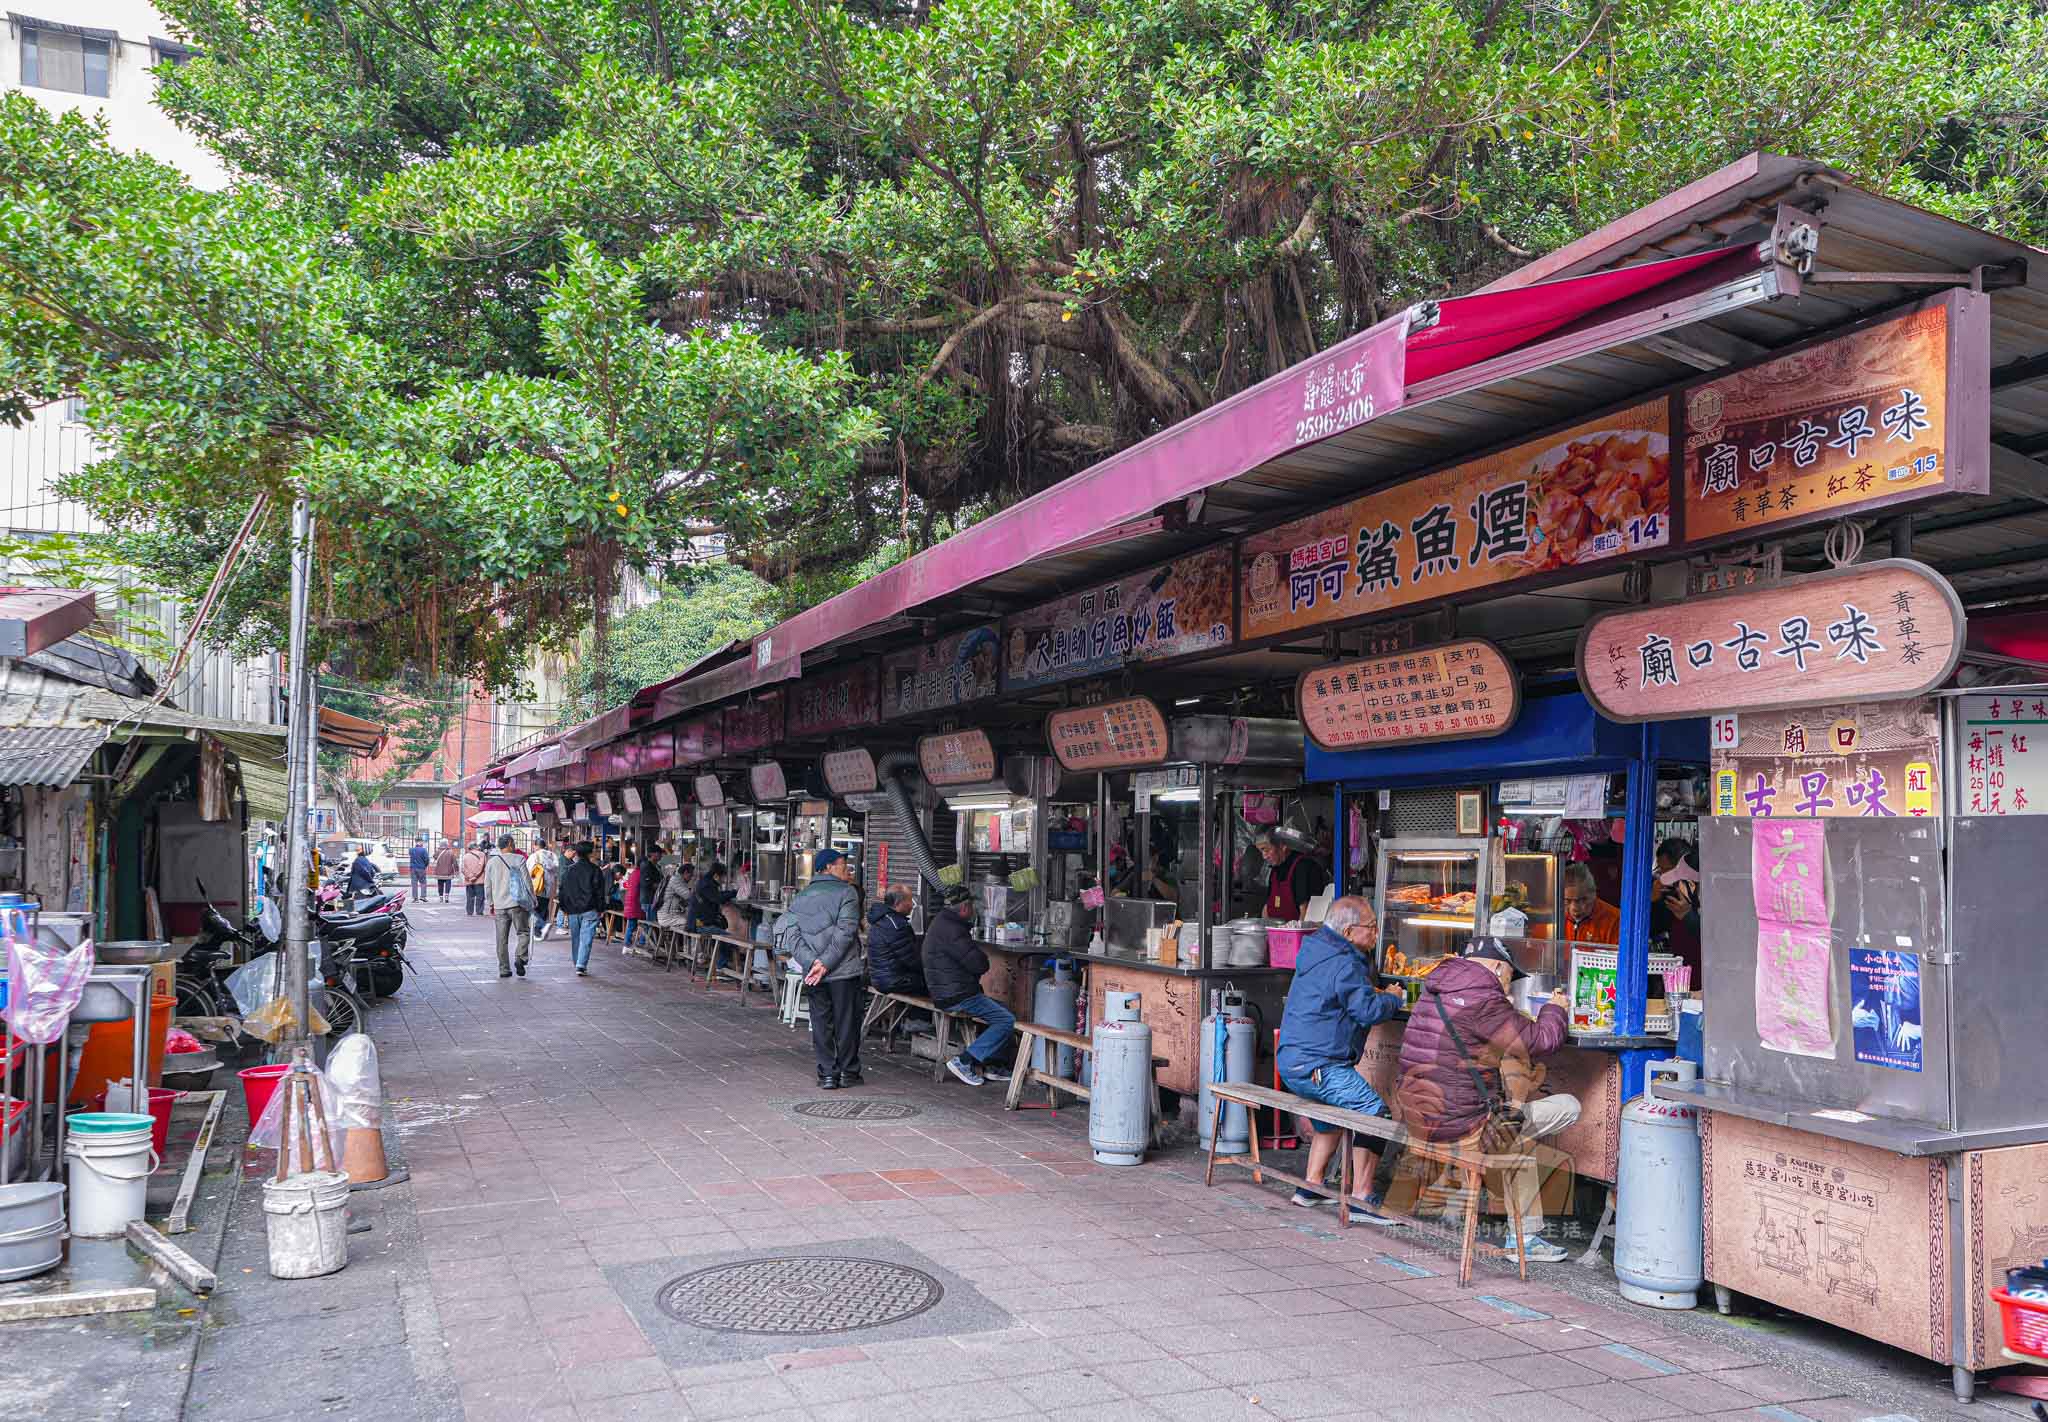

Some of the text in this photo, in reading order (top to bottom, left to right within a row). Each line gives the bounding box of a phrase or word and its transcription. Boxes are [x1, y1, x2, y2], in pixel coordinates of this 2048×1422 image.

[1702, 389, 1931, 498] 廟口古早味
[1912, 454, 1937, 474] 15
[1290, 481, 1529, 613] 阿可 鯊魚煙
[1628, 512, 1660, 545] 14
[1290, 535, 1348, 566] 媽祖宮口
[1210, 624, 1225, 641] 13
[1638, 602, 1881, 690] 廟口古早味
[1890, 590, 1924, 667] 青草茶
[1315, 671, 1361, 698] 鯊魚煙
[1418, 656, 1442, 716] 涼拌韭菜
[1449, 650, 1475, 711] 茭白筍
[1466, 647, 1490, 710] 竹筍沙拉
[1607, 643, 1631, 690] 紅茶
[1374, 728, 1386, 737] 150
[1388, 726, 1400, 736] 150
[1405, 725, 1413, 734] 50
[1420, 723, 1428, 732] 50
[1435, 721, 1444, 731] 50
[1451, 718, 1460, 728] 50
[1464, 715, 1478, 726] 100
[1481, 713, 1495, 724] 150
[1988, 698, 2047, 720] 古早味
[1714, 719, 1735, 743] 15
[1784, 723, 1856, 754] 廟口
[1743, 767, 1898, 816] 古早味
[1967, 731, 1987, 813] 每杯25元
[2011, 733, 2028, 811] 紅茶
[1718, 775, 1735, 816] 青草
[1743, 1159, 1805, 1189] 慈聖宮小吃
[1812, 1179, 1875, 1209] 慈聖宮小吃
